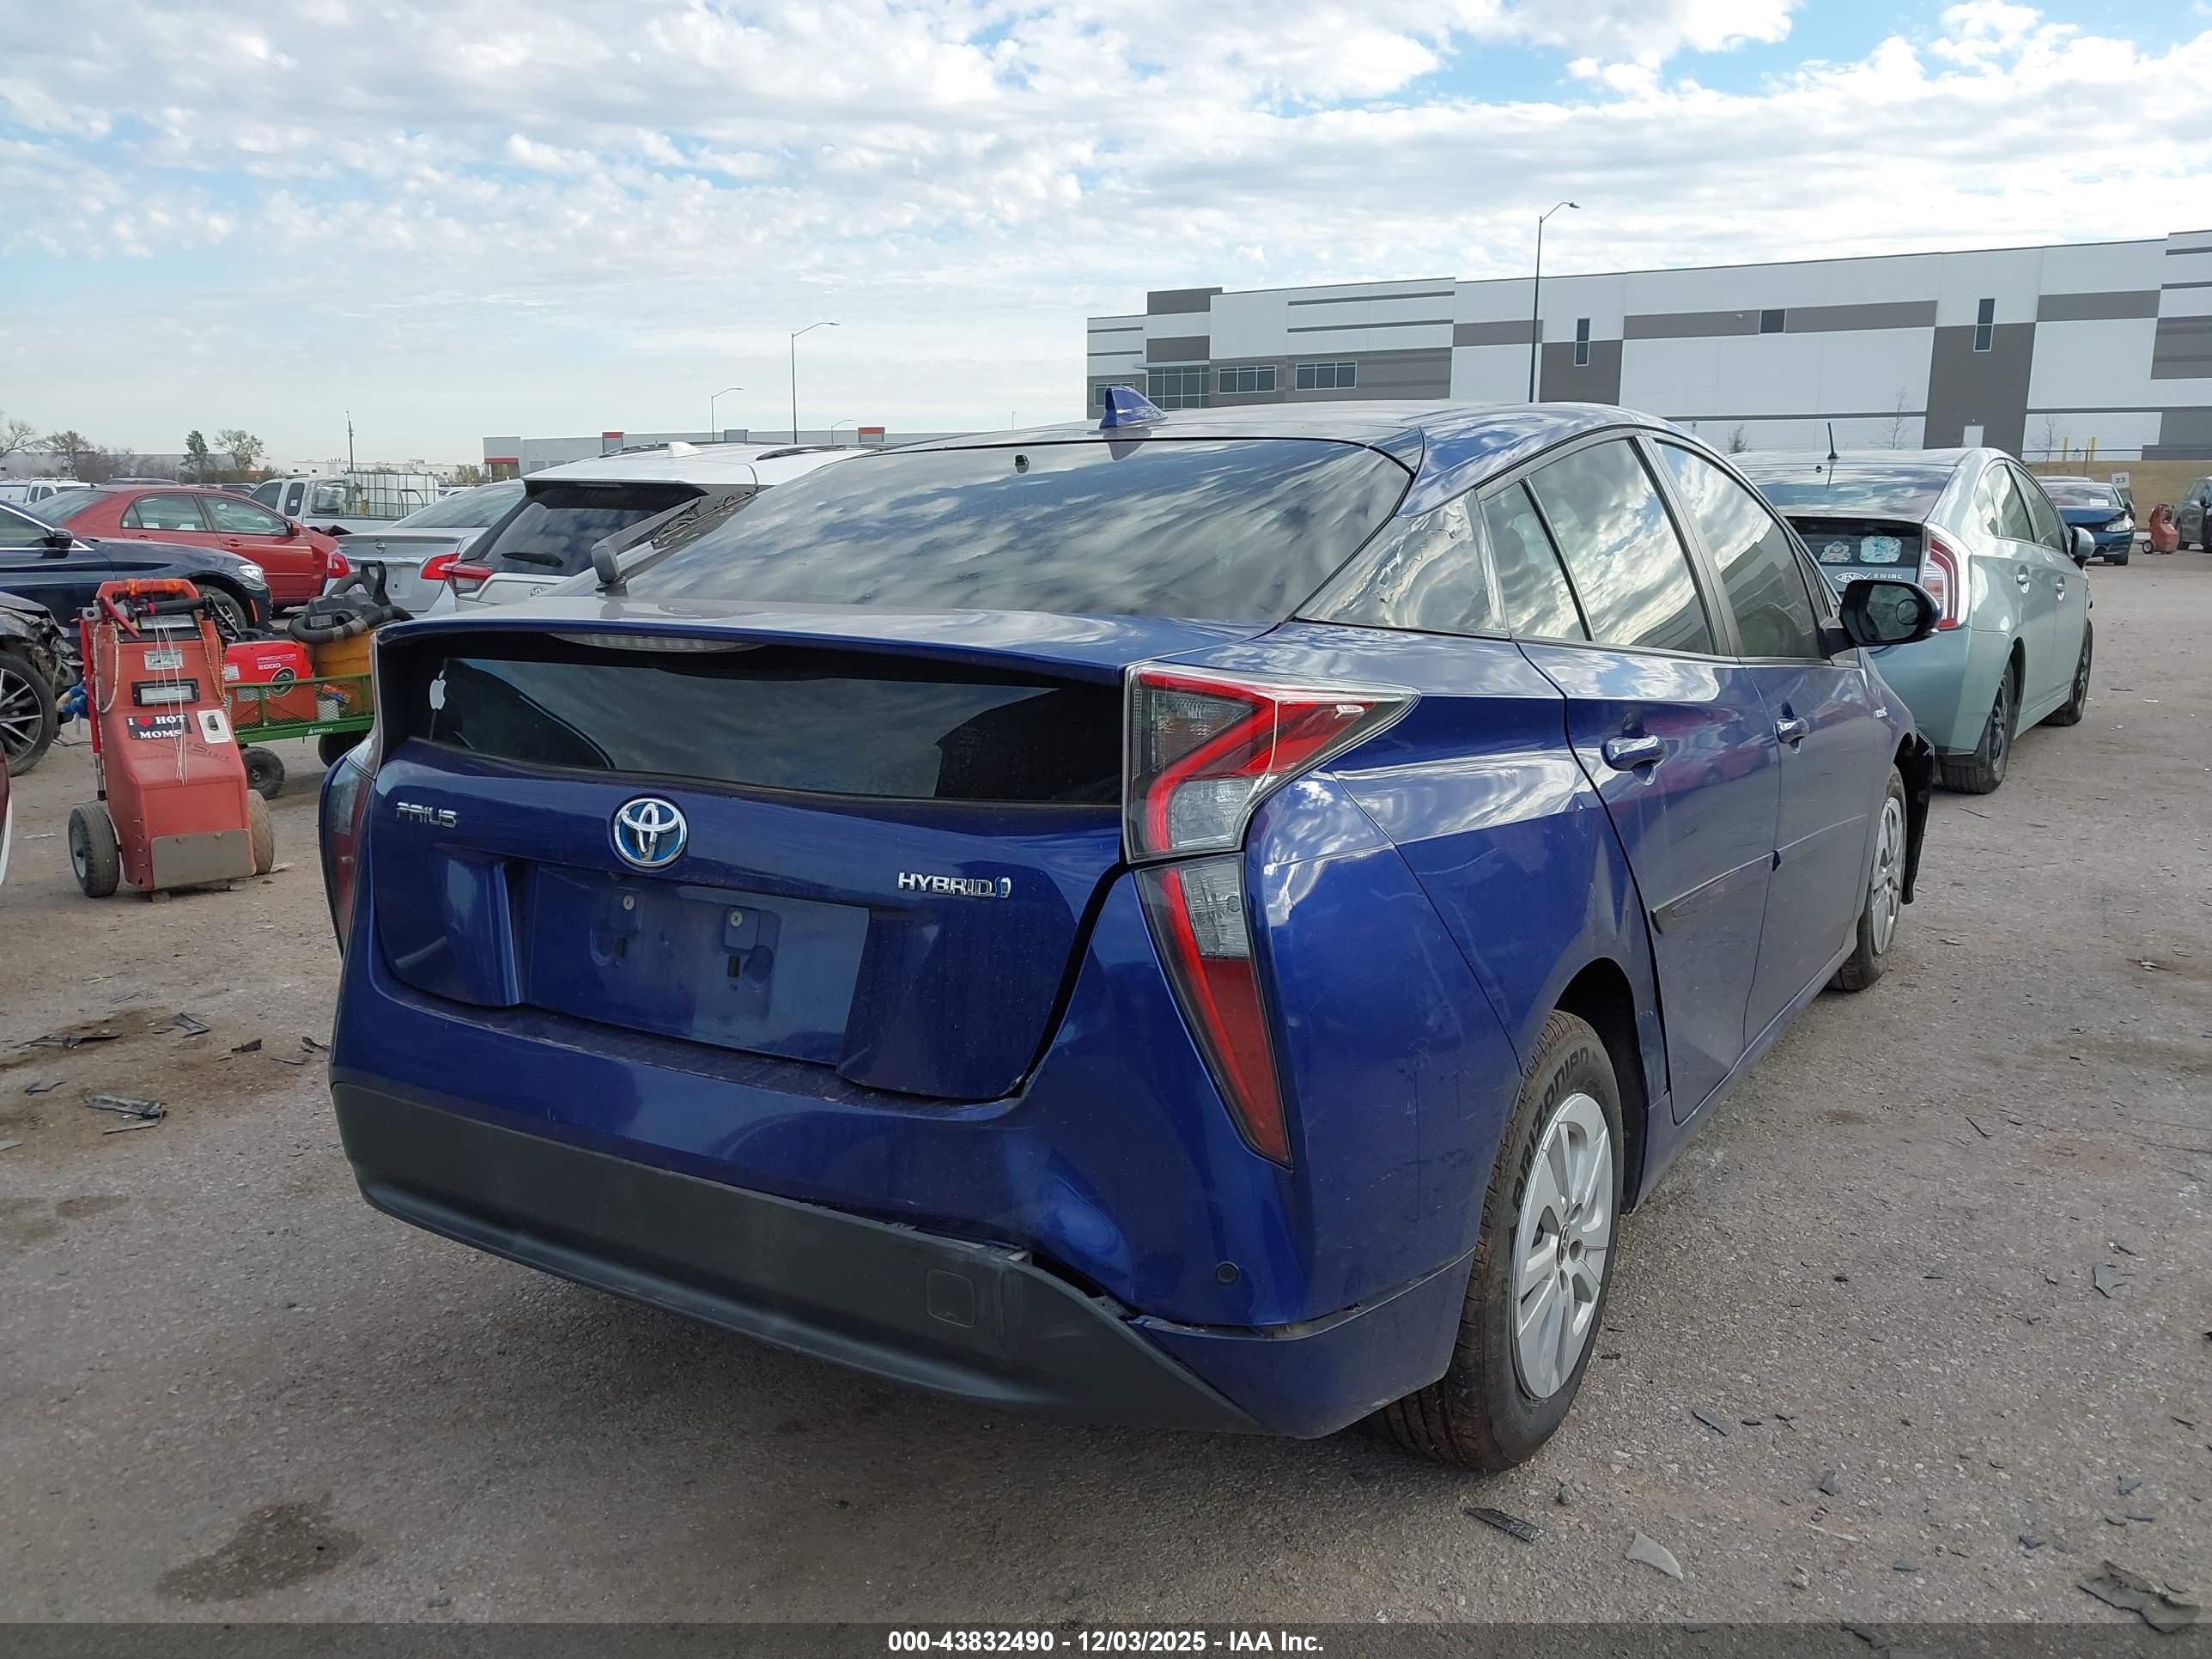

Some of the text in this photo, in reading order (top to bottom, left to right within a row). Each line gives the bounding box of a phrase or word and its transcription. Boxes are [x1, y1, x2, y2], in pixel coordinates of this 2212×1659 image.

[257, 653, 297, 663] PREDATOR
[155, 714, 186, 725] HOT
[138, 729, 184, 739] MOMS
[396, 802, 457, 829] PRIUS
[897, 872, 994, 897] HYBRID
